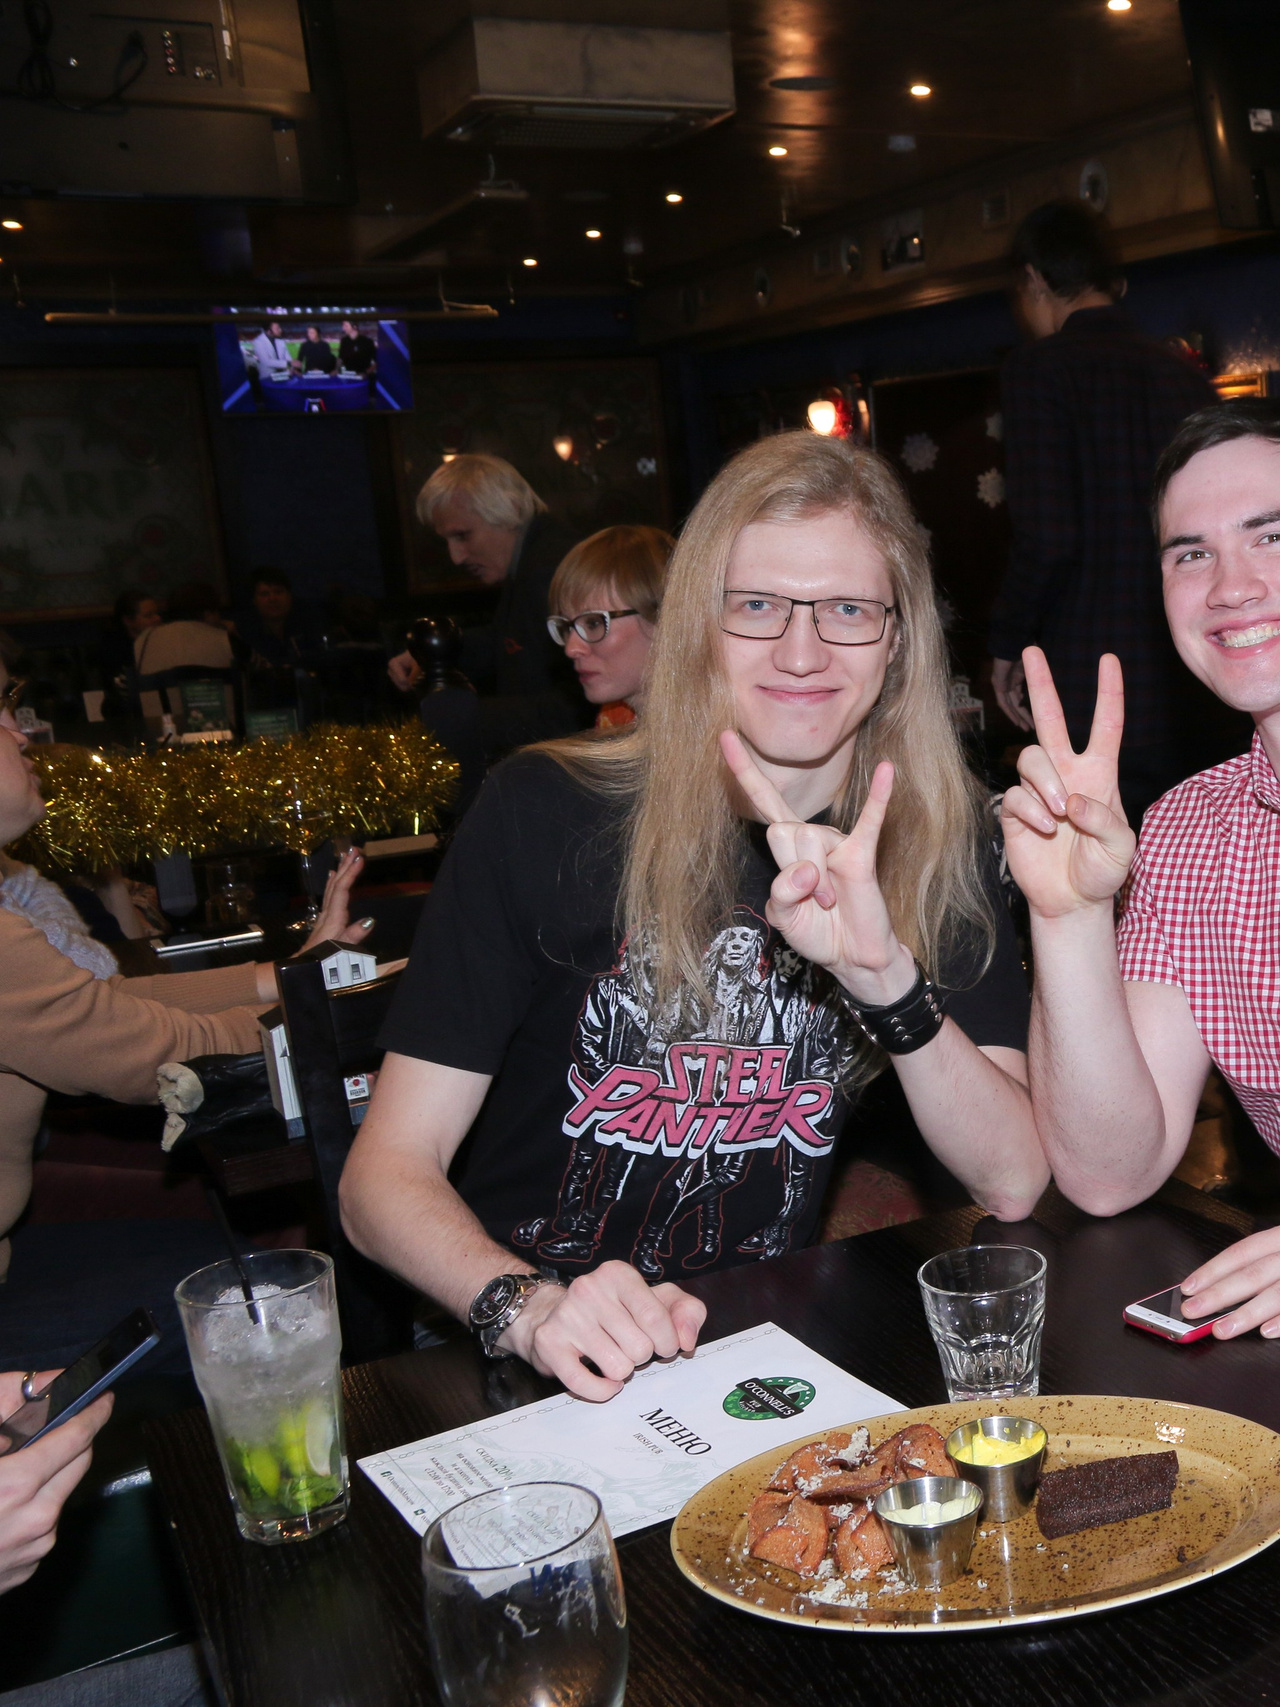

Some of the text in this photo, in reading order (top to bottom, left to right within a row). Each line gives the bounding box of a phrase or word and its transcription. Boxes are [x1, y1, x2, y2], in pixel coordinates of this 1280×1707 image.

[0, 470, 151, 519] ARP
[745, 1382, 795, 1415] O'CONNELL'S
[633, 1432, 663, 1455] IRISH PUB
[639, 1407, 712, 1456] МЕНЮ
[475, 1447, 513, 1481] СКИДКА 20%
